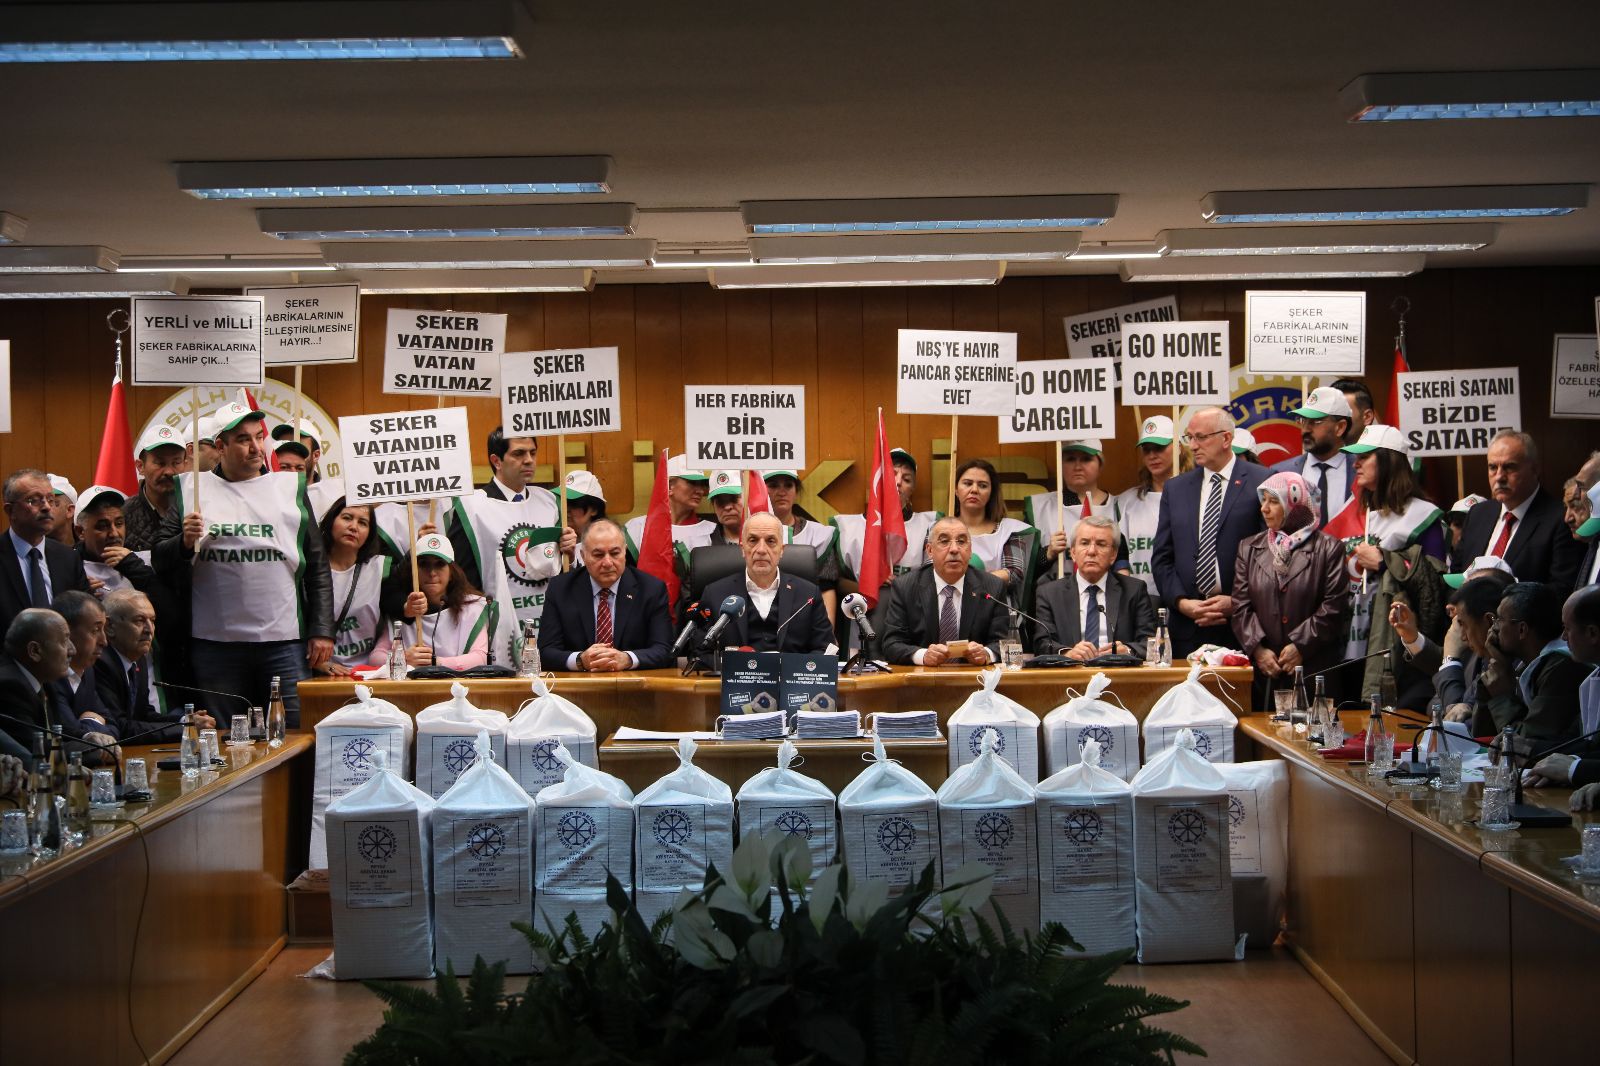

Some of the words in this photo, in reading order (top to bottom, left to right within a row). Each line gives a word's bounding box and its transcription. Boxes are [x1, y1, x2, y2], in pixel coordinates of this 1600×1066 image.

[286, 299, 318, 308] ŞEKER
[145, 315, 188, 328] YERLİ
[193, 320, 209, 328] ve
[215, 316, 252, 329] MİLLİ
[266, 312, 343, 321] ABRİKALARININ
[416, 314, 479, 332] ŞEKER
[1264, 322, 1348, 330] FABRİKALARININ
[265, 324, 353, 336] ELLEŞTİRİLMESİNE
[1070, 313, 1120, 342] ŞEKERİ
[176, 342, 256, 351] FABRİKALARINA
[281, 337, 321, 346] HAYIR...!
[398, 334, 494, 352] VATANDIR
[1129, 334, 1154, 358] GO
[1163, 333, 1221, 357] HOME
[1254, 336, 1358, 344] ÖZELLEŞTİRİLMESİNE
[169, 355, 197, 363] SAHİP
[964, 343, 998, 358] HAYIR
[414, 355, 475, 370] VATAN
[534, 354, 584, 377] ŞEKER
[395, 374, 492, 391] SATILMAZ
[901, 365, 950, 380] PANCAR
[955, 364, 1013, 383] ŞEKERİNE
[1043, 368, 1106, 393] HOME
[1134, 371, 1218, 395] CARGILL
[508, 380, 612, 404] FABRİKALARI
[944, 389, 971, 404] EVET
[1404, 377, 1455, 402] ŞEKERİ
[1460, 378, 1514, 397] SATANI
[696, 394, 725, 407] HER
[732, 391, 795, 408] FABRİKA
[512, 408, 611, 432] SATILMASIN
[1012, 406, 1102, 432] CARGILL
[1229, 395, 1302, 426] ÜRK
[1422, 404, 1496, 424] BİZDE
[369, 415, 437, 436] ŞEKER
[727, 413, 764, 434] BİR
[354, 434, 457, 456] VATANDIR
[698, 438, 793, 459] KALEDİR
[1408, 427, 1513, 451] SATARI
[374, 457, 440, 476] VATAN
[357, 476, 462, 498] SATILMAZ
[208, 523, 275, 540] ŞEKER
